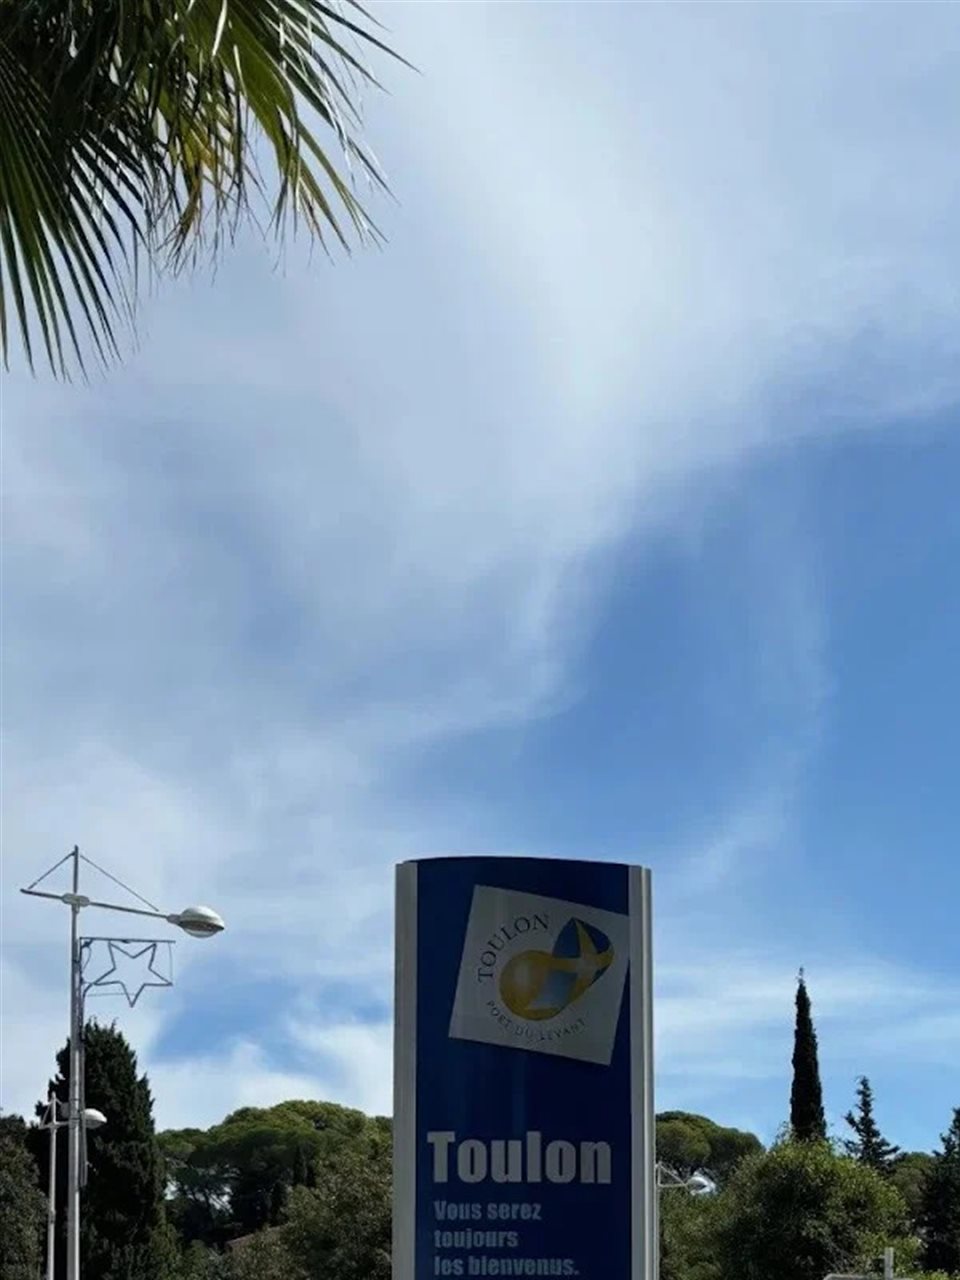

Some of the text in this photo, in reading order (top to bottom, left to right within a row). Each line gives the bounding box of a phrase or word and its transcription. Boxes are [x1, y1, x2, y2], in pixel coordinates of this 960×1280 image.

[477, 913, 551, 983] TOULON
[427, 1131, 612, 1184] Toulon
[434, 1201, 542, 1220] Vous serez
[434, 1228, 519, 1249] toujours
[434, 1256, 580, 1276] les bienvenus.
